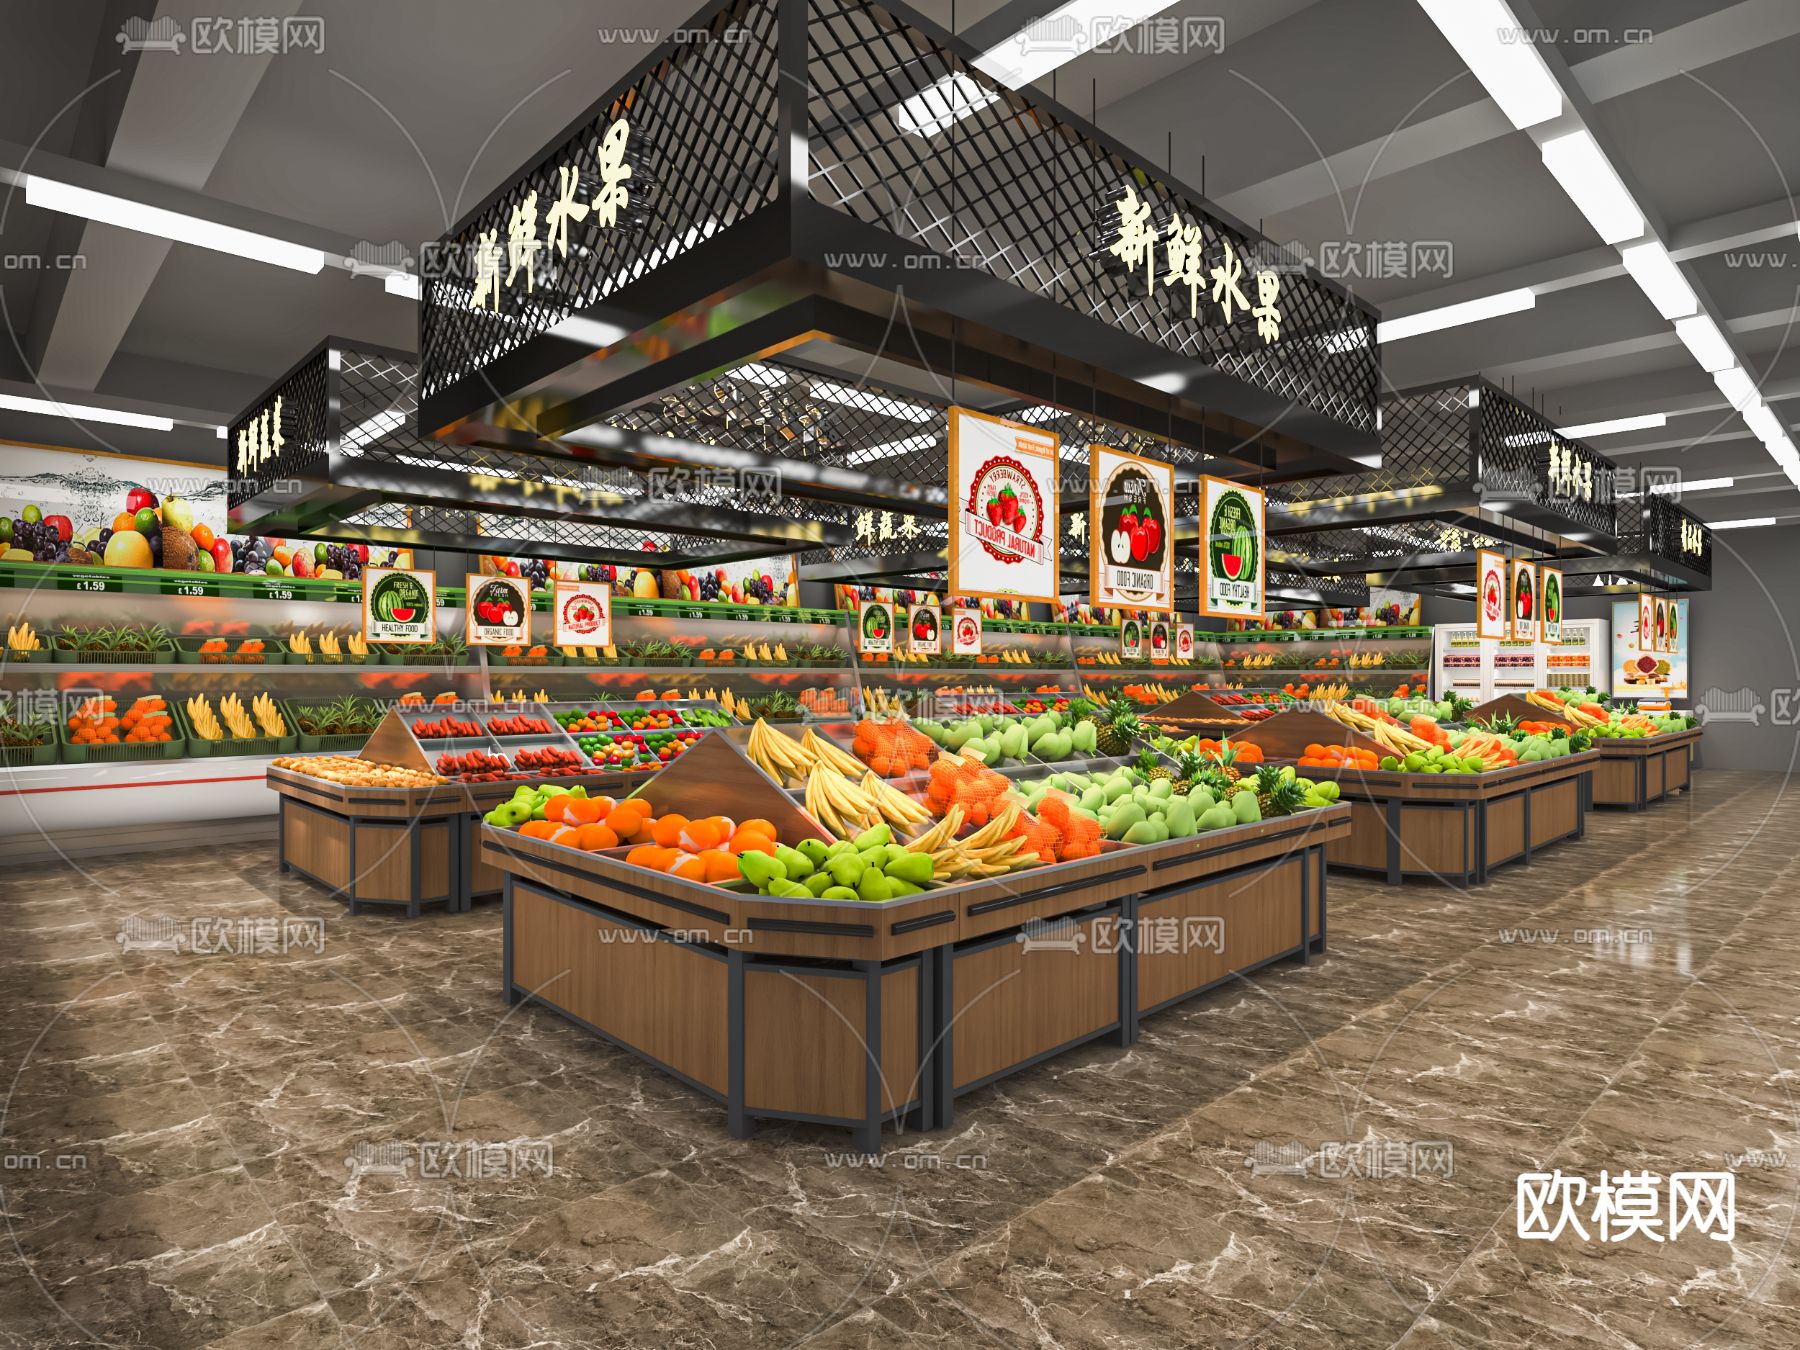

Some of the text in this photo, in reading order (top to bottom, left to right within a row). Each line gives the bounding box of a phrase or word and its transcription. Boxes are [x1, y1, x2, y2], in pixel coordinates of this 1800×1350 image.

[1110, 184, 1282, 344] 新鲜水果
[381, 624, 419, 633] HEALTHY FOOD
